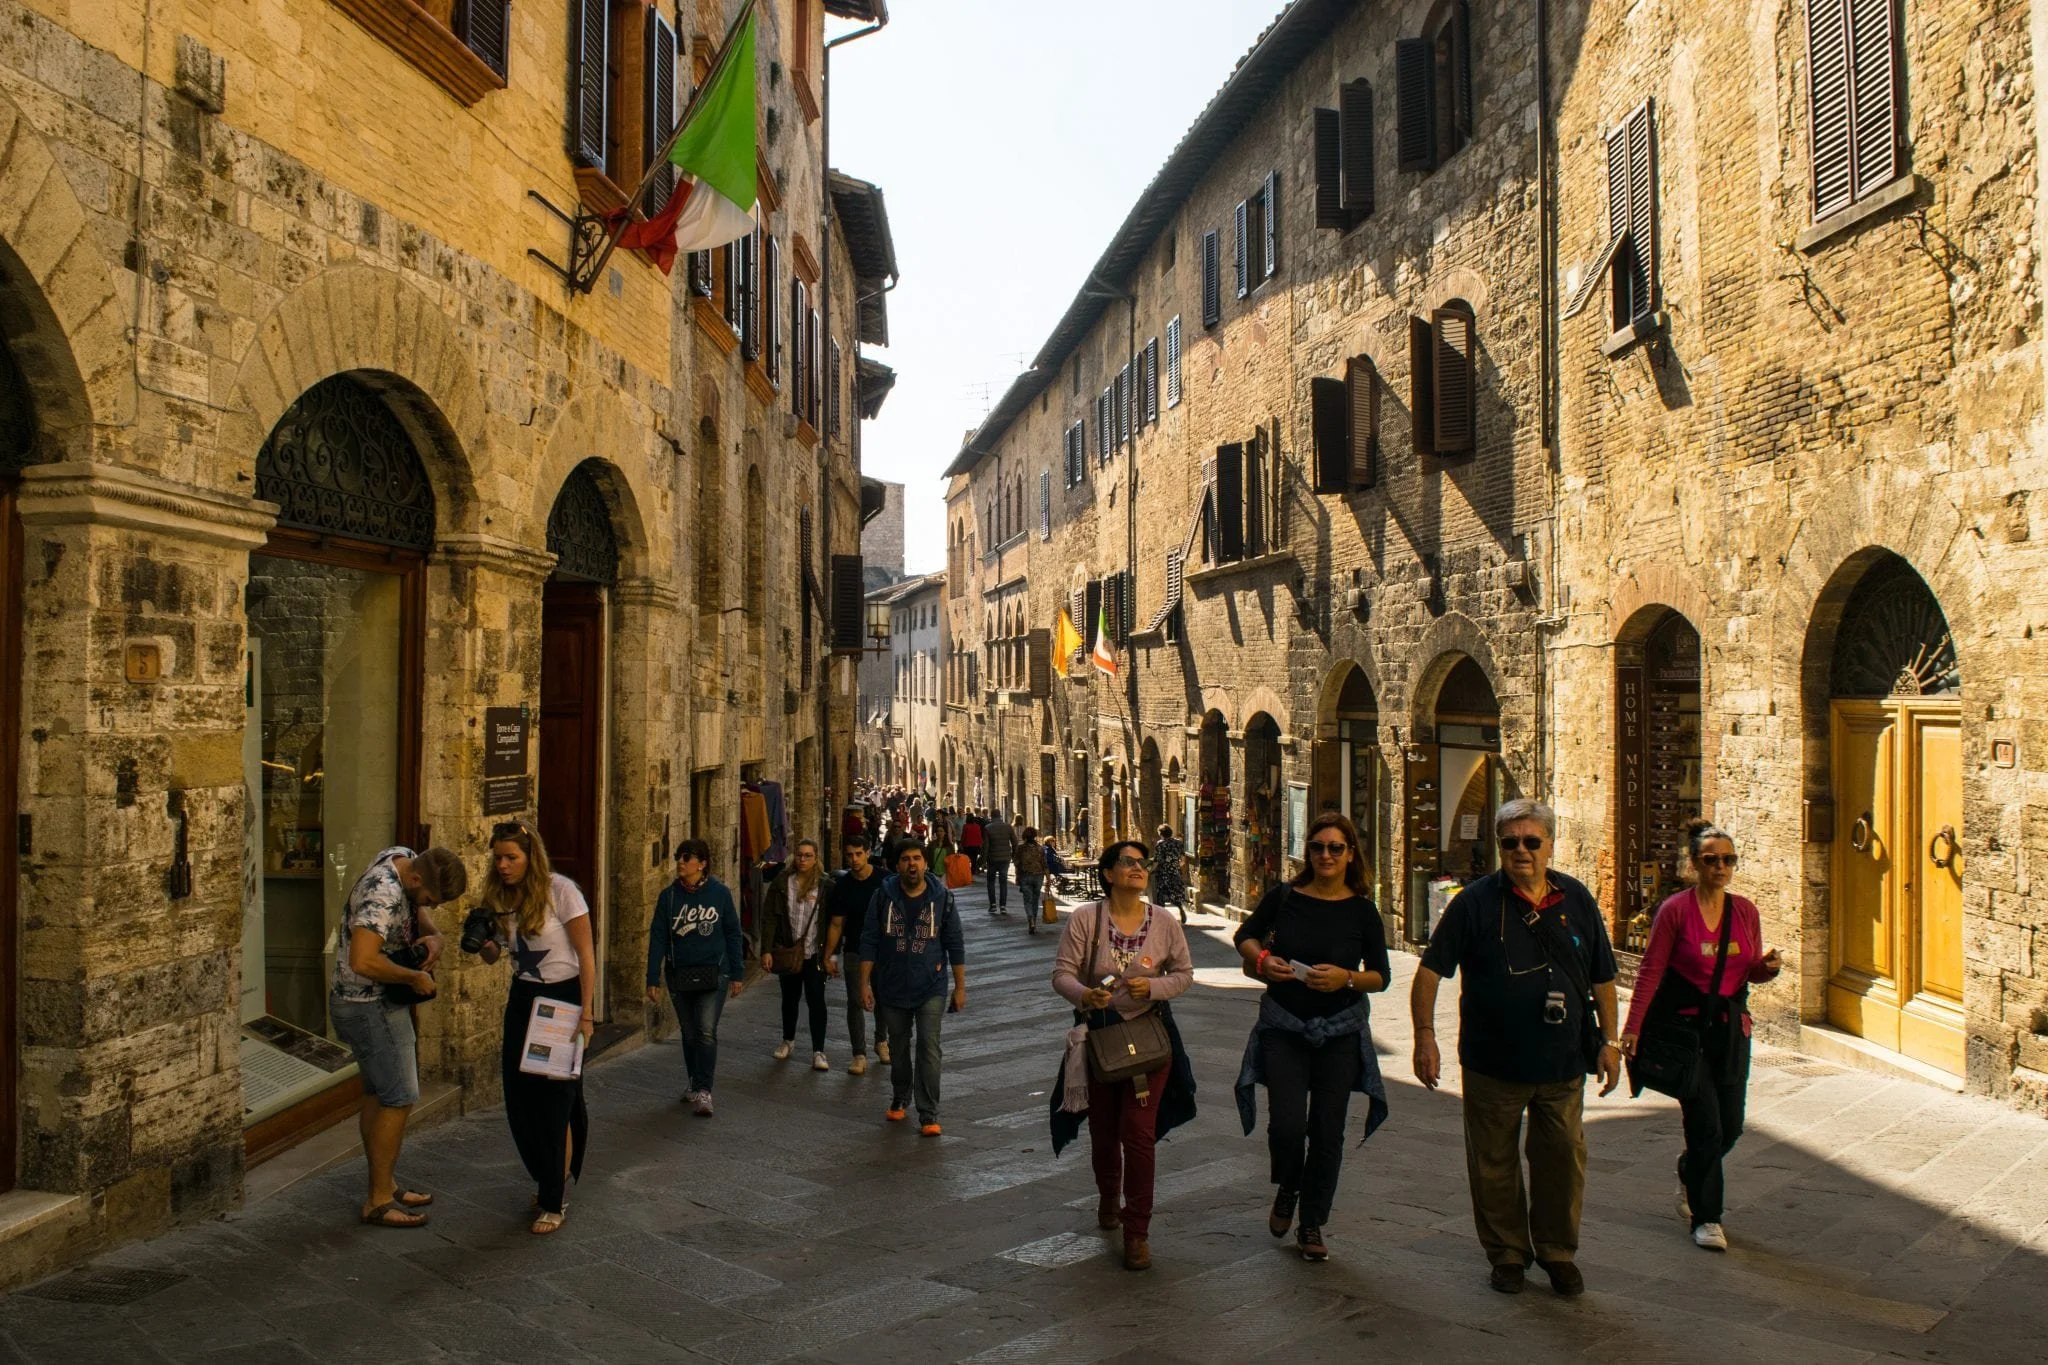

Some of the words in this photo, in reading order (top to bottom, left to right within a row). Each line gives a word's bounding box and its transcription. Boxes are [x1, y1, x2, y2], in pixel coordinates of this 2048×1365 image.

[1624, 682, 1637, 738] HOME
[1625, 753, 1638, 807] MADE
[1626, 823, 1639, 906] SALUMI
[671, 903, 719, 931] Aero
